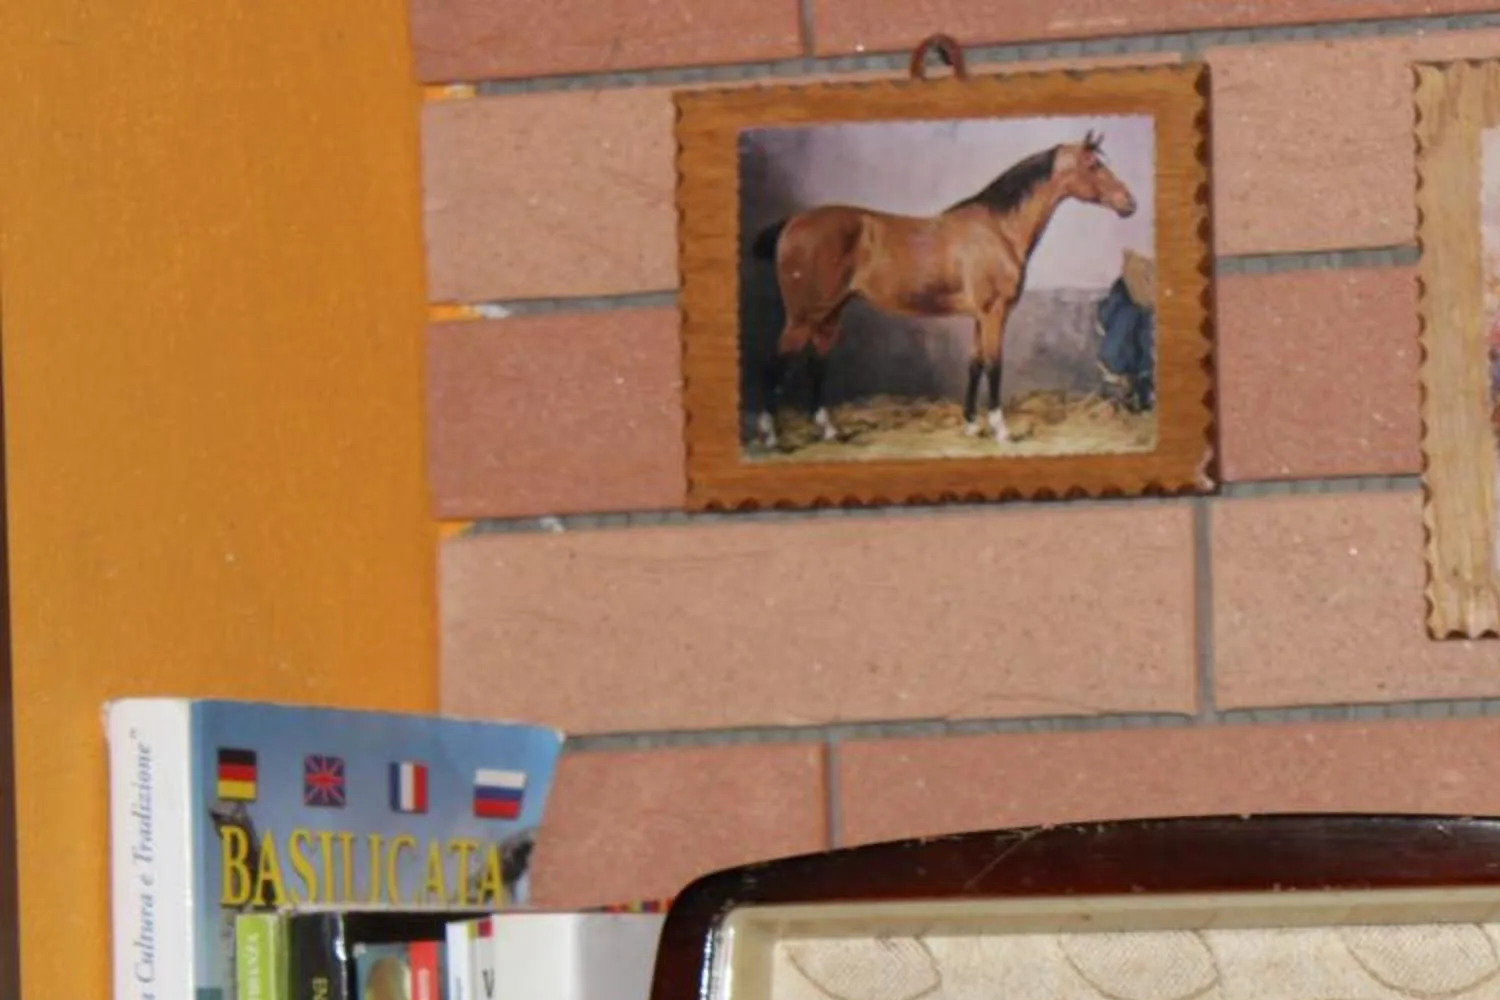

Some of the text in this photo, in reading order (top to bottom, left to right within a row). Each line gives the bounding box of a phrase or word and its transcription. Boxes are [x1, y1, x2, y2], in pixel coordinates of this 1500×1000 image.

[139, 875, 155, 887] e
[220, 825, 506, 908] BASILICATA
[133, 892, 156, 984] Cultura
